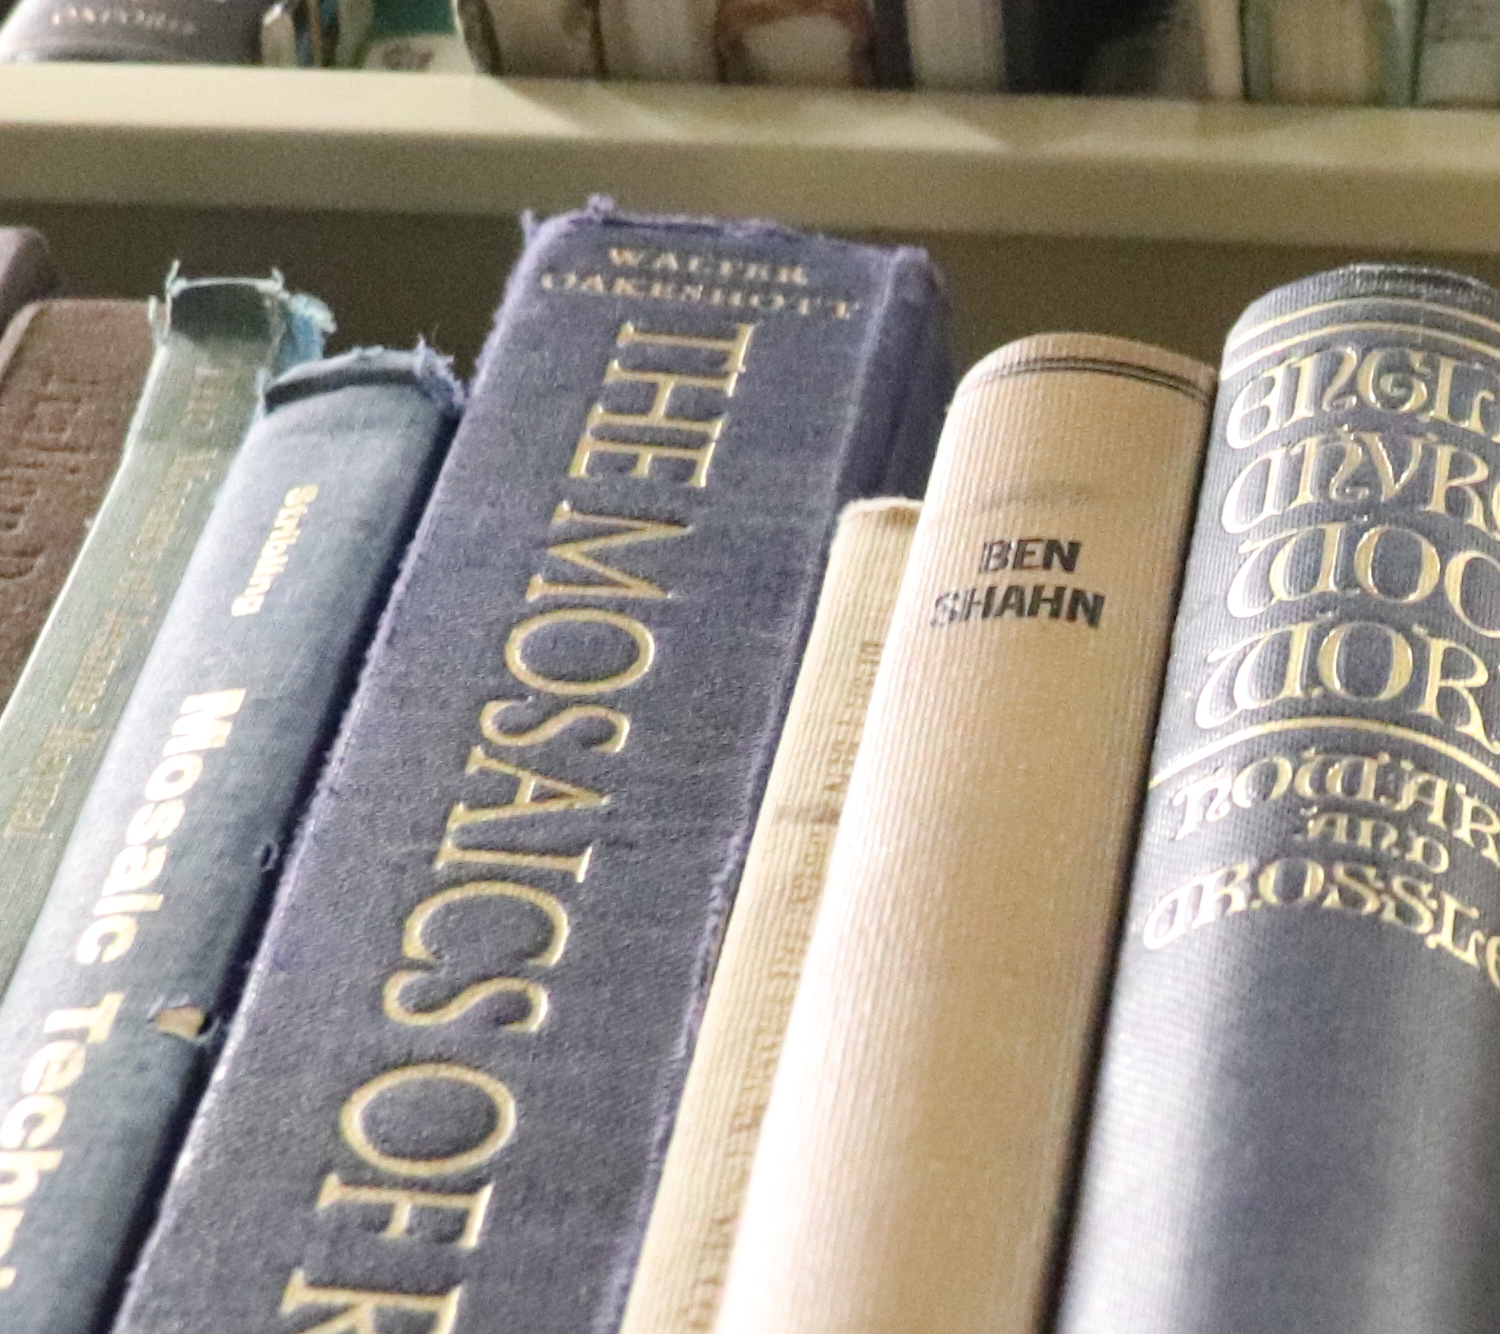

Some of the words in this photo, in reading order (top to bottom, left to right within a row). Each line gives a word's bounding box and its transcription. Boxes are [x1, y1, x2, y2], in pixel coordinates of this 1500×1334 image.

[539, 270, 862, 321] OAKESHOTT
[606, 244, 809, 287] WALTER
[567, 321, 758, 489] THE
[224, 483, 324, 617] Stribling
[979, 536, 1082, 576] BEN
[928, 582, 1107, 631] SHAHN
[376, 499, 695, 1041] MOSAICS
[64, 685, 251, 965] Mosaic
[1294, 803, 1452, 879] AND
[314, 1061, 521, 1251] OF
